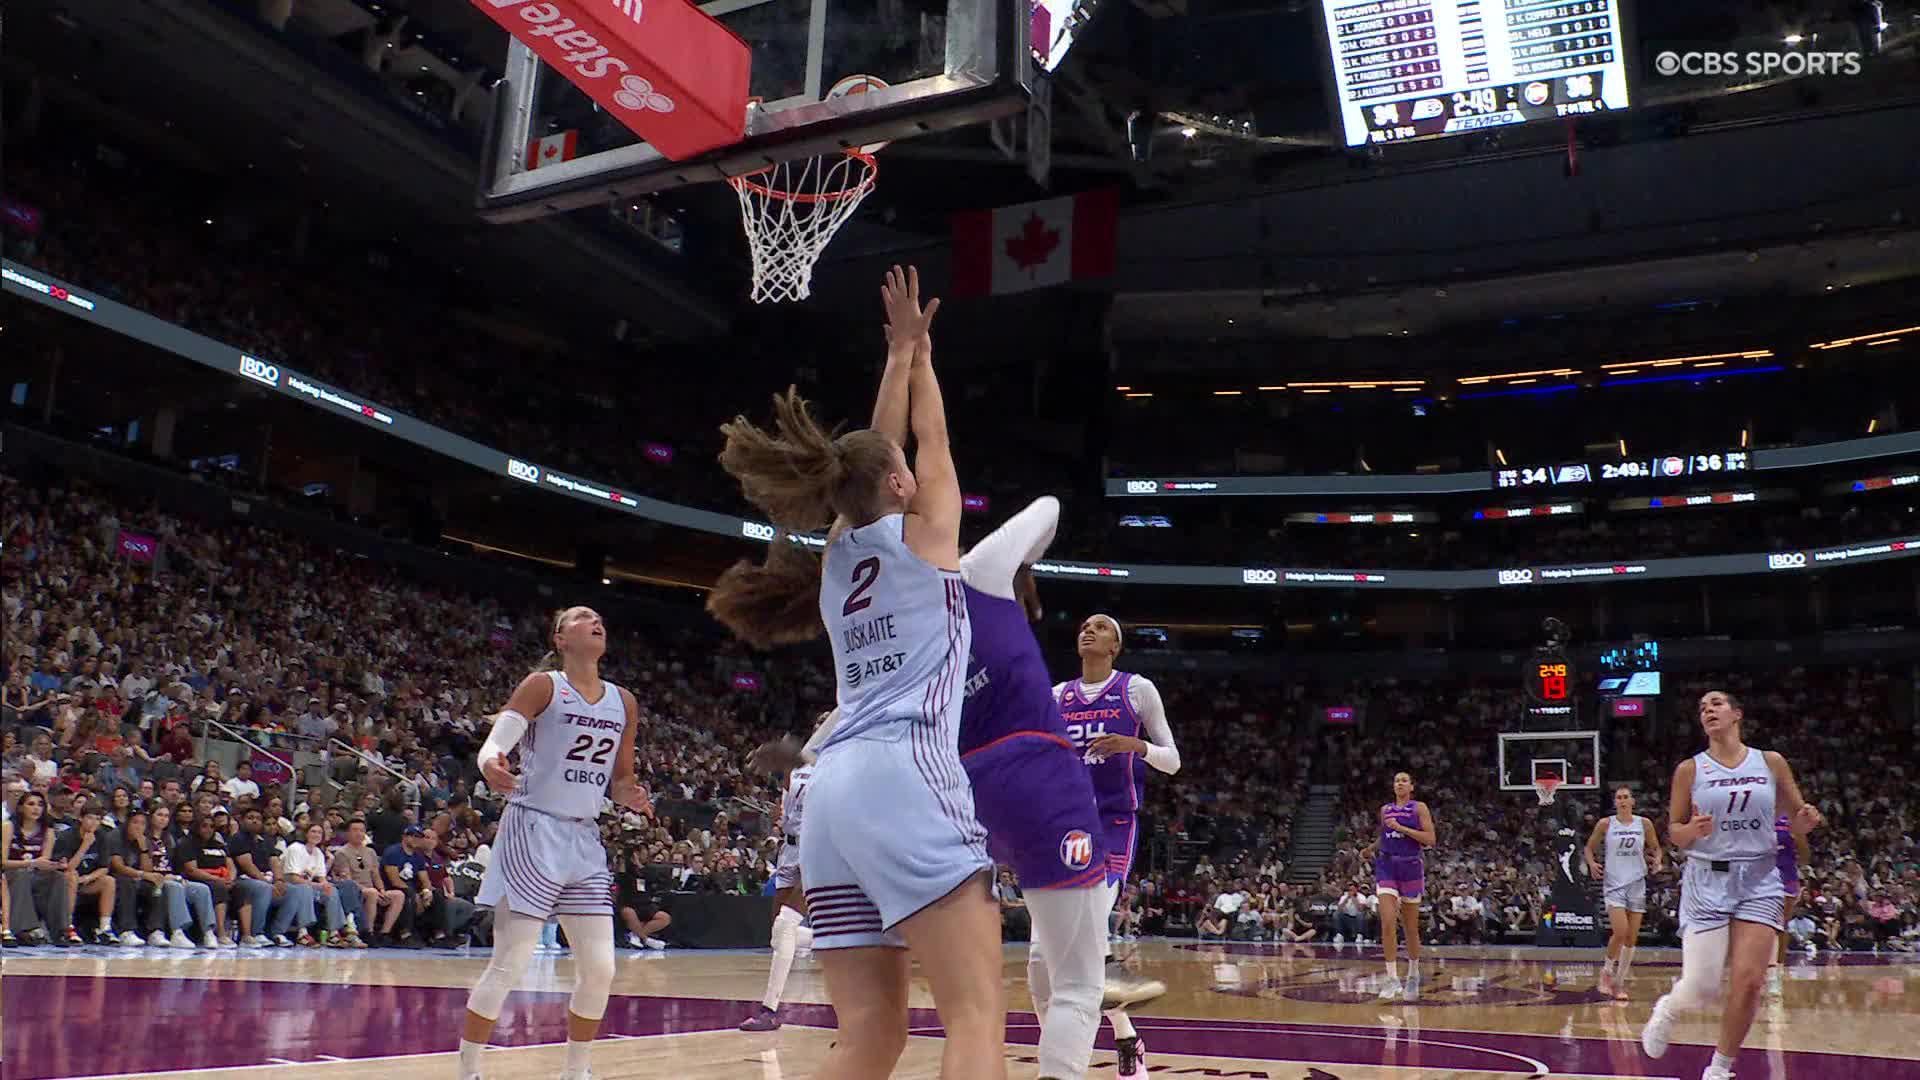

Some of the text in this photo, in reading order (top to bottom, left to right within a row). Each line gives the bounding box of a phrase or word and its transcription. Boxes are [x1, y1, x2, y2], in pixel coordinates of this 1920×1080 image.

[519, 2, 629, 78] State
[1455, 113, 1514, 130] TEMPO
[244, 356, 279, 383] BDO
[288, 376, 320, 399] Helping
[510, 459, 539, 481] BDO
[1522, 467, 1547, 485] 34
[1602, 462, 1640, 478] 2:49
[1696, 454, 1722, 472] 36
[1130, 480, 1158, 491] BDO
[1891, 475, 1920, 486] LIGHT
[1686, 496, 1712, 505] LIGHT
[1732, 493, 1755, 502] ZONE
[1350, 514, 1374, 523] LIGHT
[1392, 513, 1413, 522] ZONE
[1507, 508, 1532, 517] LIGHT
[1551, 505, 1572, 514] ZONE
[748, 522, 775, 538] BDO
[1774, 553, 1806, 566] BDO
[1815, 550, 1846, 561] Helping
[1847, 545, 1892, 557] businesses
[1247, 569, 1277, 581] BDO
[1285, 572, 1314, 582] Helping
[1503, 568, 1533, 581] BDO
[1541, 569, 1572, 578] Helping
[1572, 567, 1613, 577] businesses
[842, 556, 880, 617] 2
[864, 652, 906, 679] AT&T
[1540, 664, 1567, 677] 2:49
[1543, 677, 1566, 699] 19
[1540, 706, 1572, 714] TISSOT
[562, 712, 622, 734] TEMPO
[565, 734, 615, 765] 22
[1707, 776, 1768, 788] TEMPO
[1727, 790, 1752, 814] 11
[1619, 837, 1636, 849] 10
[1555, 916, 1594, 924] PRIDE
